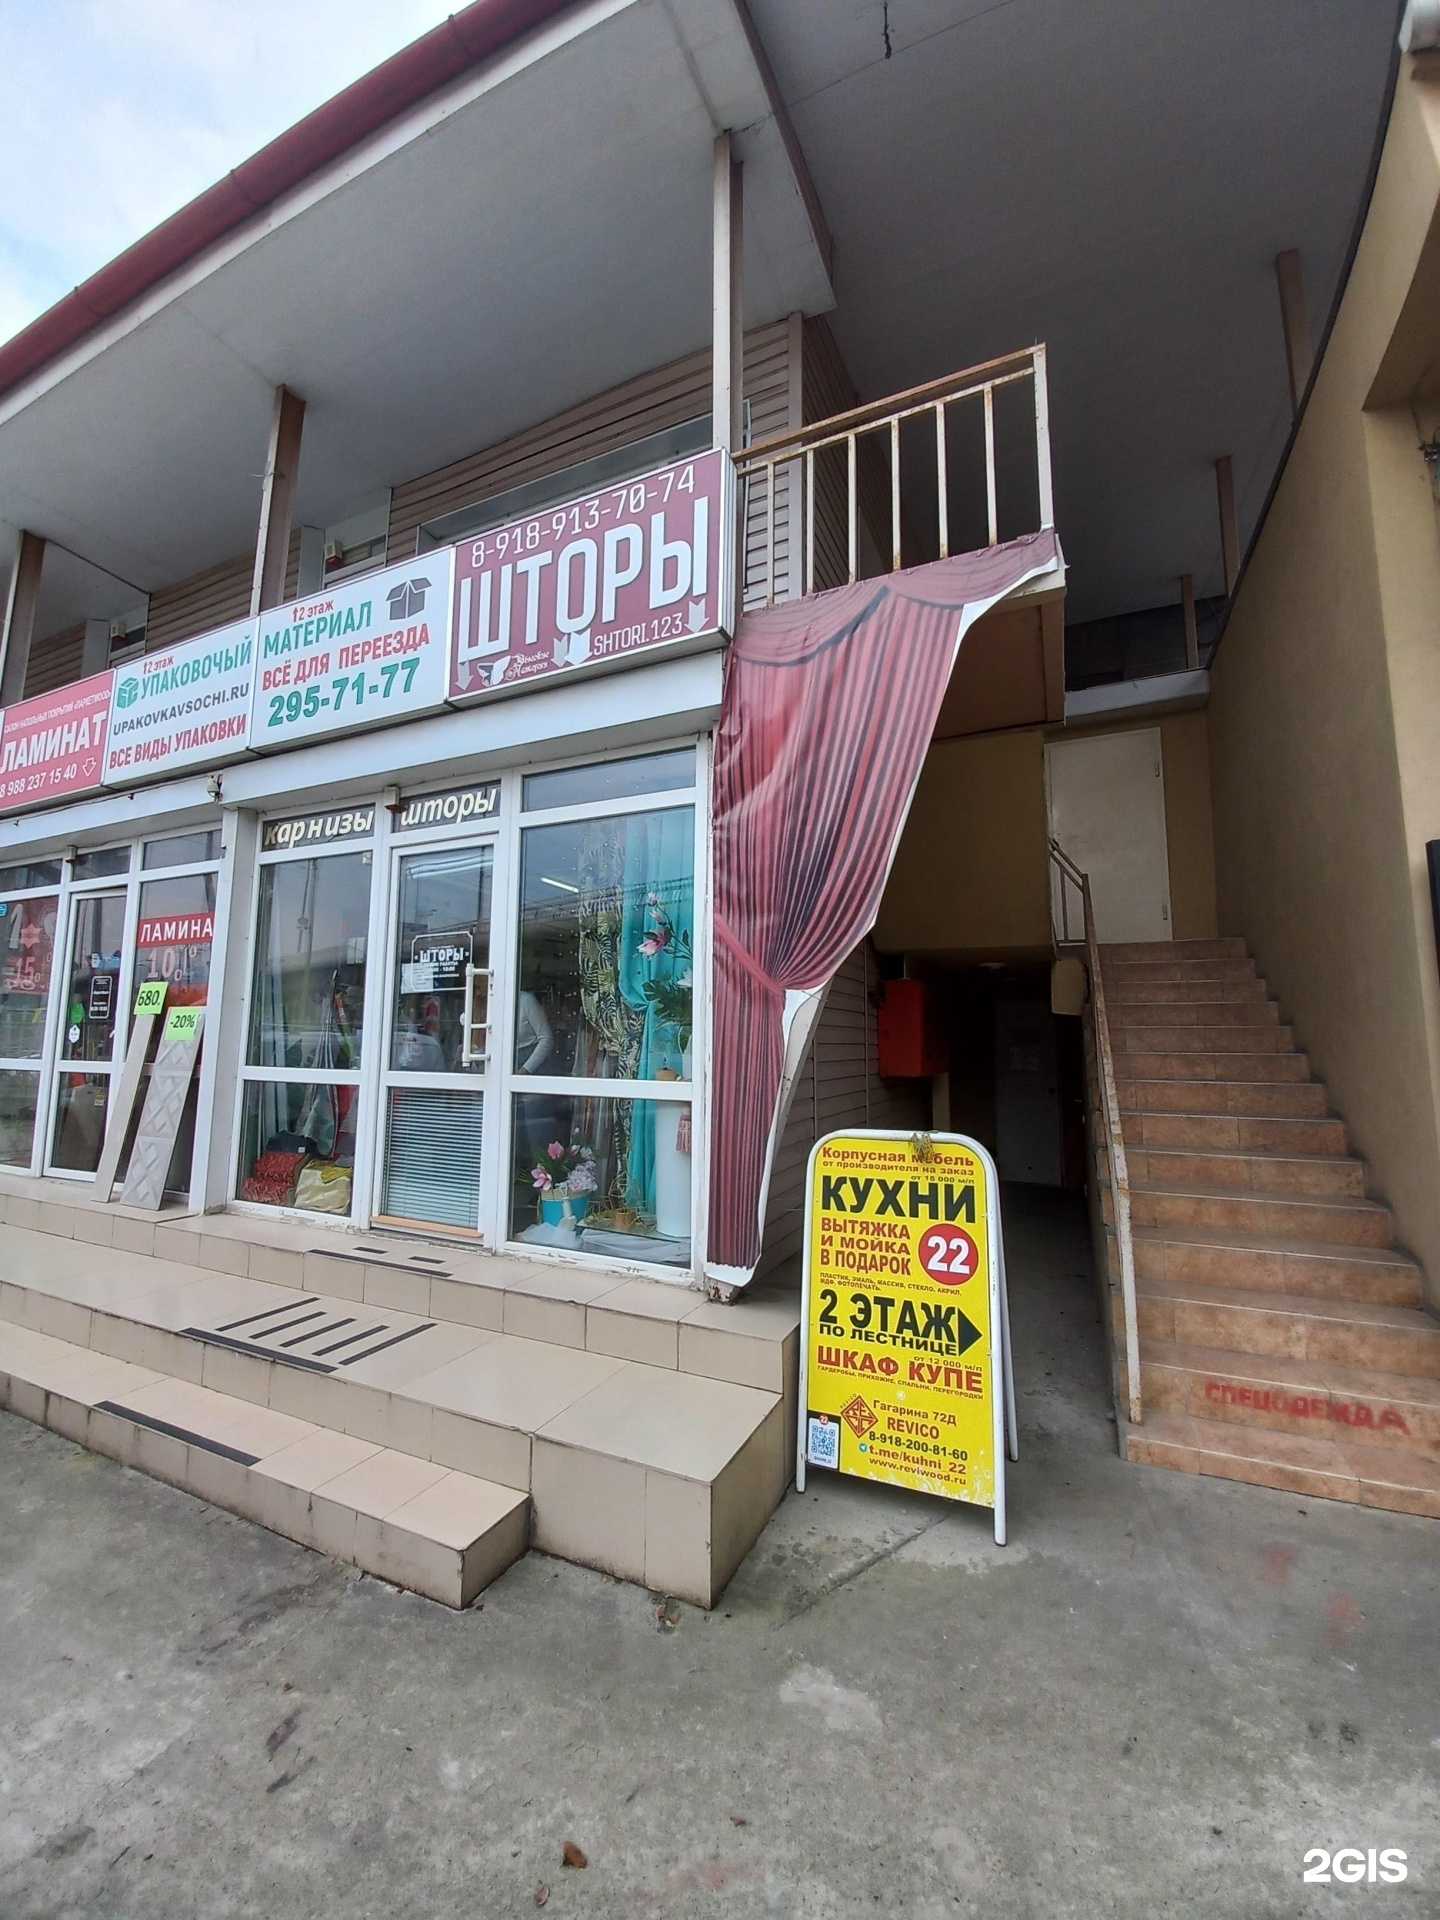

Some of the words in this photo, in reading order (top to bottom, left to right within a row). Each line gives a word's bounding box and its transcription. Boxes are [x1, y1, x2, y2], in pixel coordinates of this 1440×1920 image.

[472, 464, 695, 568] 8-918-913-70-74
[457, 496, 708, 663] ШТОРЫ
[307, 600, 335, 618] этаж
[263, 600, 372, 659] МАТЕРИАЛ
[593, 612, 683, 656] SHTORI.123
[140, 635, 252, 699] УПАКОВОЧЫЙ
[155, 656, 174, 671] этаж
[262, 657, 291, 691] ВСЁ
[293, 652, 330, 686] ДЛЯ
[339, 623, 430, 670] ПЕРЕЕЗДА
[113, 682, 250, 736] UPAKOVKAVSOCHI.RU
[268, 657, 421, 728] 295-71-77
[0, 710, 107, 774] ЛАМИНАТ
[109, 746, 132, 769] ВСЕ
[134, 736, 172, 763] ВИДЫ
[174, 714, 248, 752] УПАКОВКИ
[0, 783, 6, 799] 8
[7, 777, 26, 796] 988
[27, 772, 46, 791] 237
[49, 767, 62, 785] 15
[63, 763, 77, 781] 40
[264, 810, 374, 849] карнизы
[401, 788, 497, 823] шторы
[420, 947, 465, 963] ШТОРЫ
[170, 1014, 195, 1028] -20%
[822, 1147, 906, 1163] Корпусная
[836, 1161, 919, 1173] производителя
[922, 1166, 937, 1174] на
[940, 1168, 974, 1176] заказ
[821, 1175, 976, 1224] КУХНИ
[821, 1217, 911, 1240] ВЫТЯЖКА
[821, 1234, 833, 1247] И
[840, 1235, 911, 1256] МОЙКА
[820, 1249, 830, 1266] В
[835, 1250, 911, 1276] ПОДАРОК
[927, 1235, 970, 1275] 22
[819, 1288, 838, 1325] 2
[849, 1293, 956, 1343] ЭТАЖ
[819, 1323, 845, 1337] ПО
[850, 1328, 957, 1356] ЛЕСТНИЦЕ
[817, 1345, 899, 1376] ШКАФ
[909, 1360, 983, 1394] КУПЕ
[873, 1400, 929, 1419] Гагарина
[933, 1411, 957, 1426] 72Д
[887, 1417, 939, 1440] REVICO
[868, 1431, 968, 1461] 8-918-200-81-60
[869, 1458, 966, 1485] www.reviwood.ru
